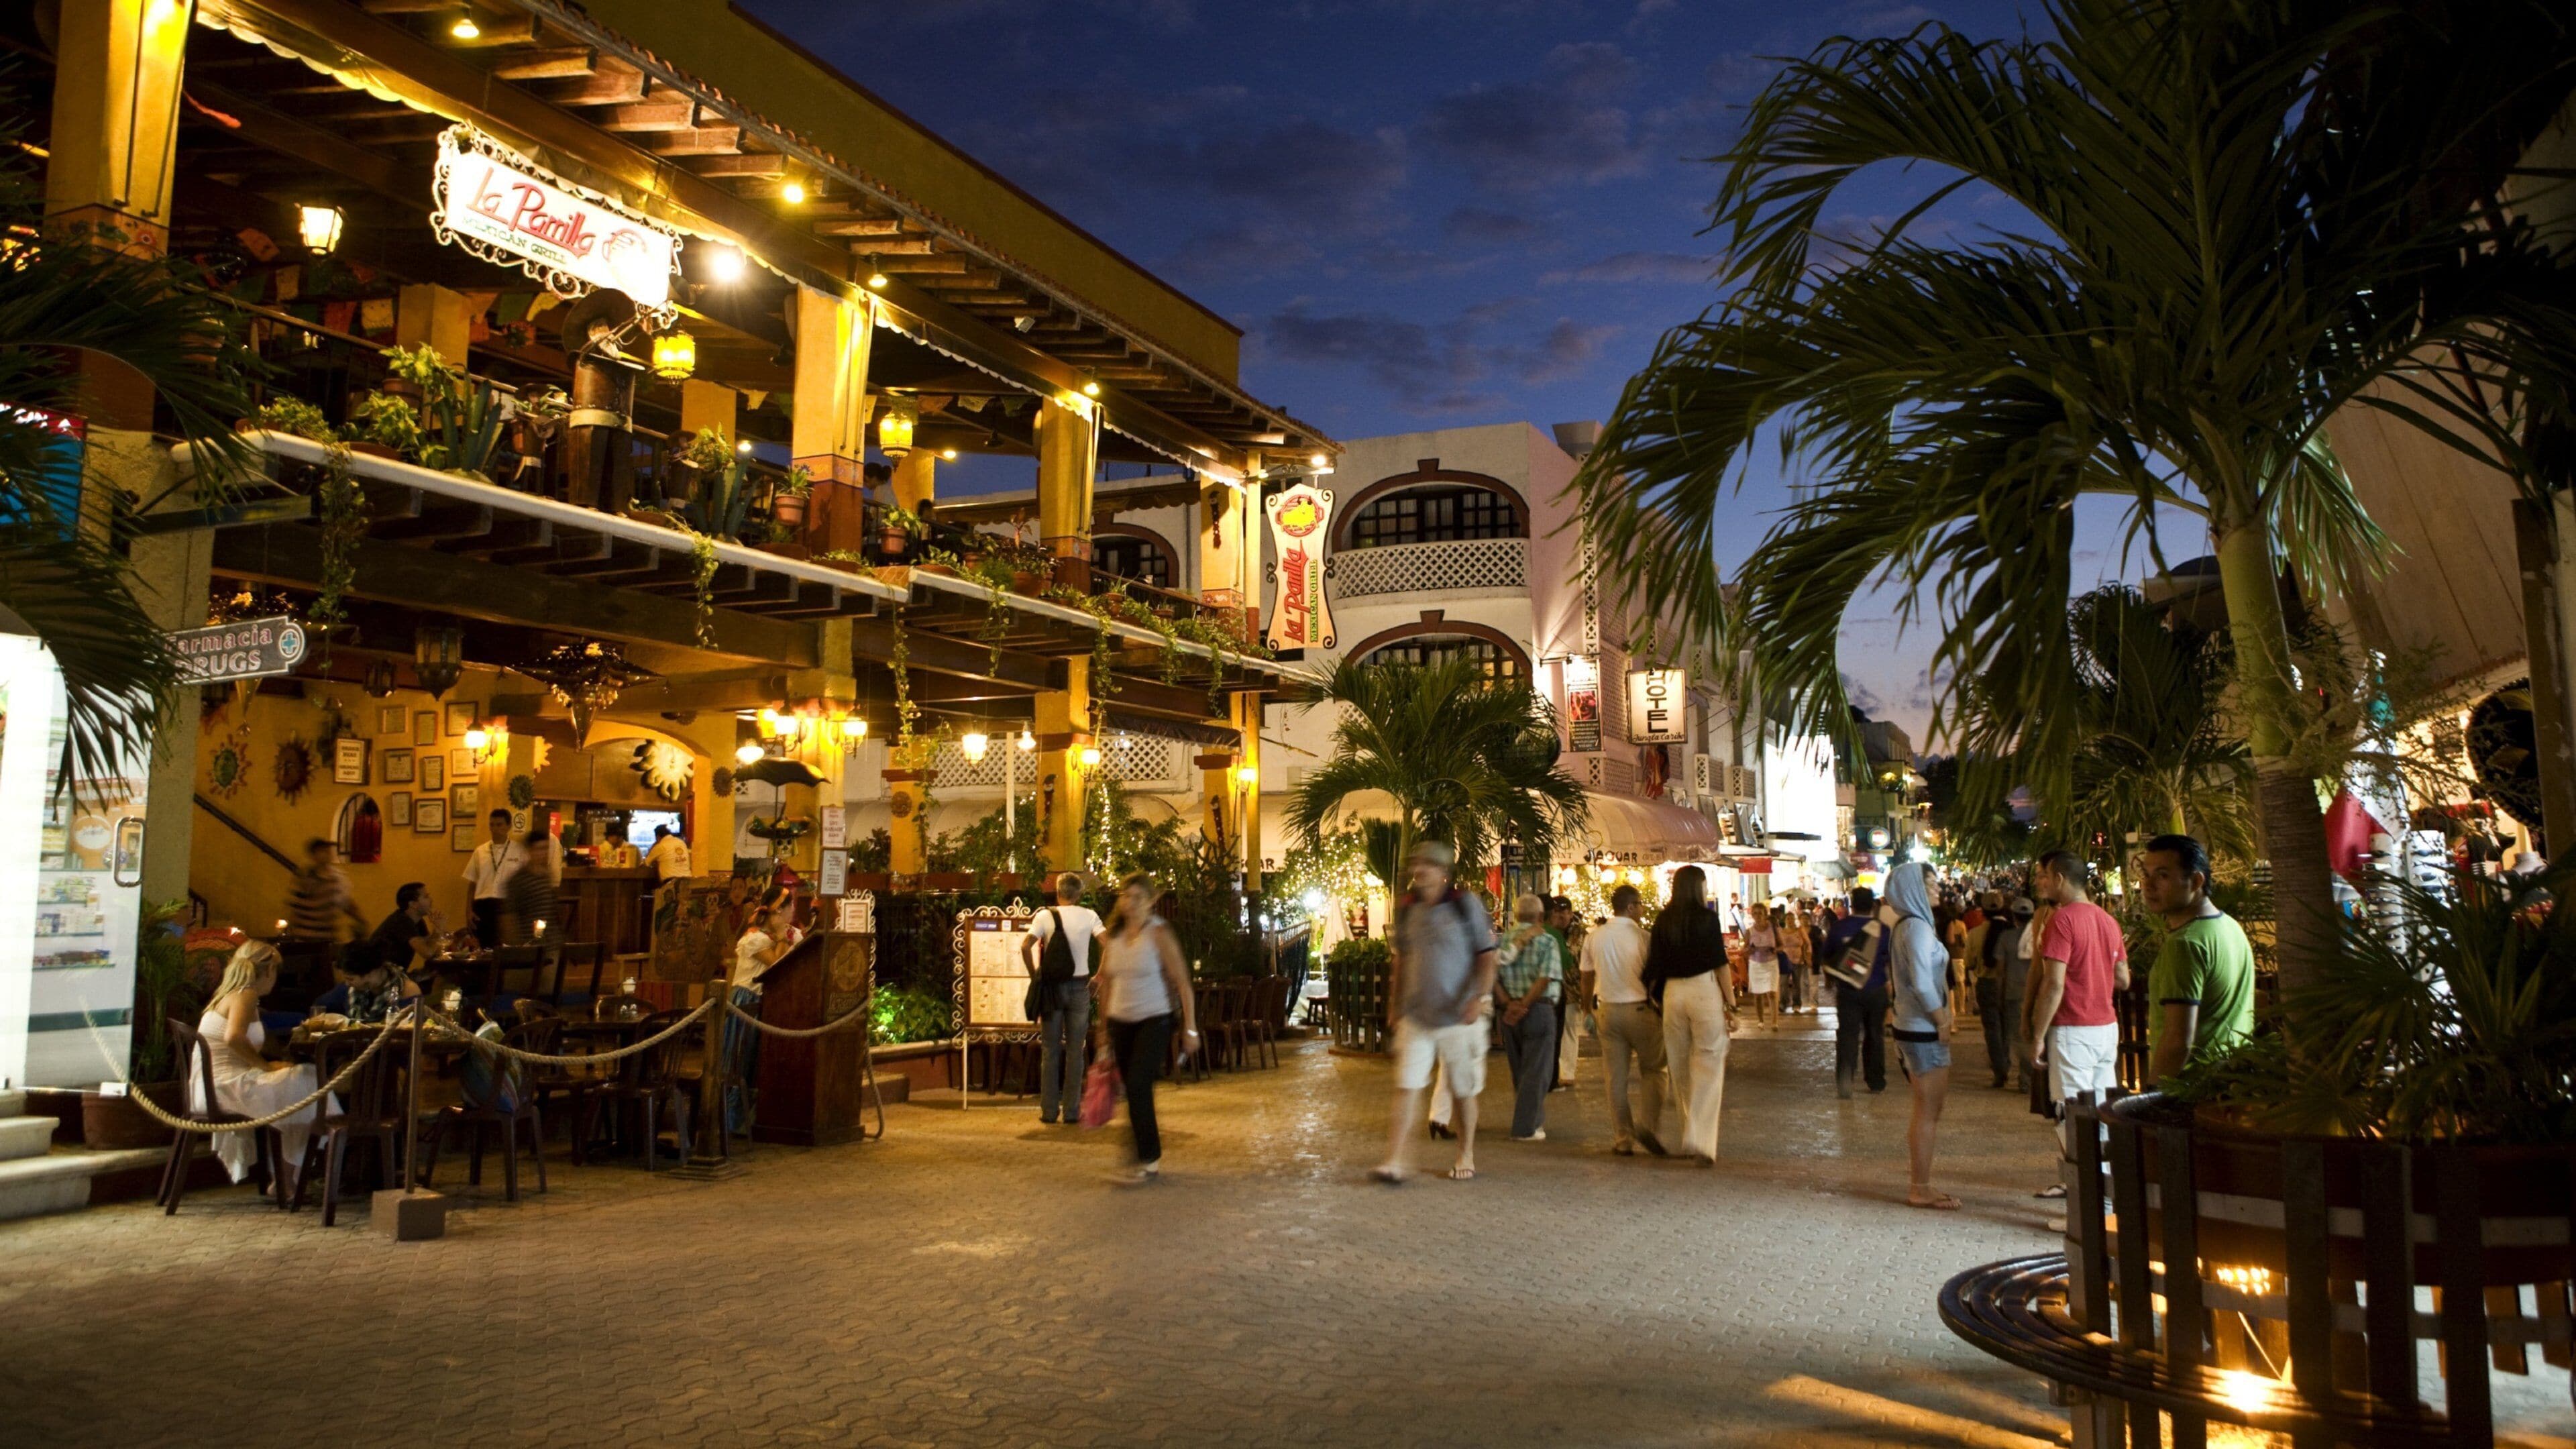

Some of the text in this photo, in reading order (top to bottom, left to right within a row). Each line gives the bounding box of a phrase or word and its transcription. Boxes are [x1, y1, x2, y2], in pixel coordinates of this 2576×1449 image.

[462, 216, 566, 264] MEXICAN GRILL
[466, 167, 596, 259] La Parrilla
[1283, 539, 1311, 644] La Parrilla
[1309, 559, 1318, 642] MEXICAN GRILL
[1646, 671, 1668, 733] HOTEL
[1584, 849, 1638, 863] JAGUAR
